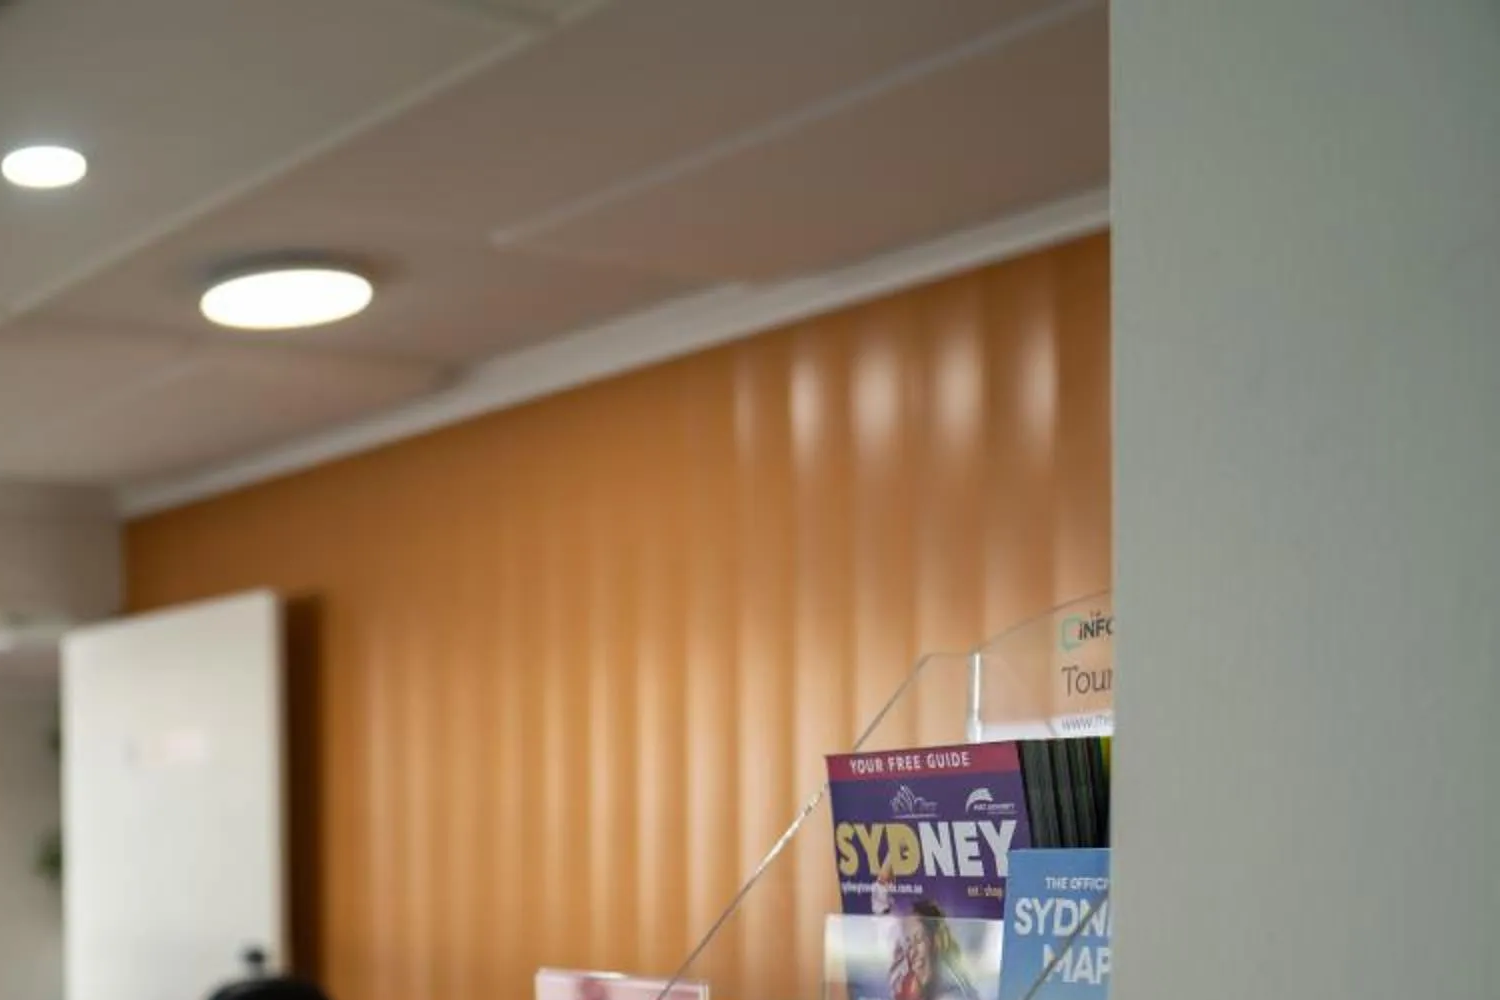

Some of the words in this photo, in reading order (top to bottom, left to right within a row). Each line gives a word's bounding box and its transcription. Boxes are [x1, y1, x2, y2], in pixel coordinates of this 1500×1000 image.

[850, 757, 883, 774] YOUR
[887, 754, 921, 772] FREE
[927, 751, 972, 769] GUIDE
[836, 820, 1017, 877] SYDNEY
[1045, 876, 1067, 889] THE
[1043, 944, 1112, 984] MAP
